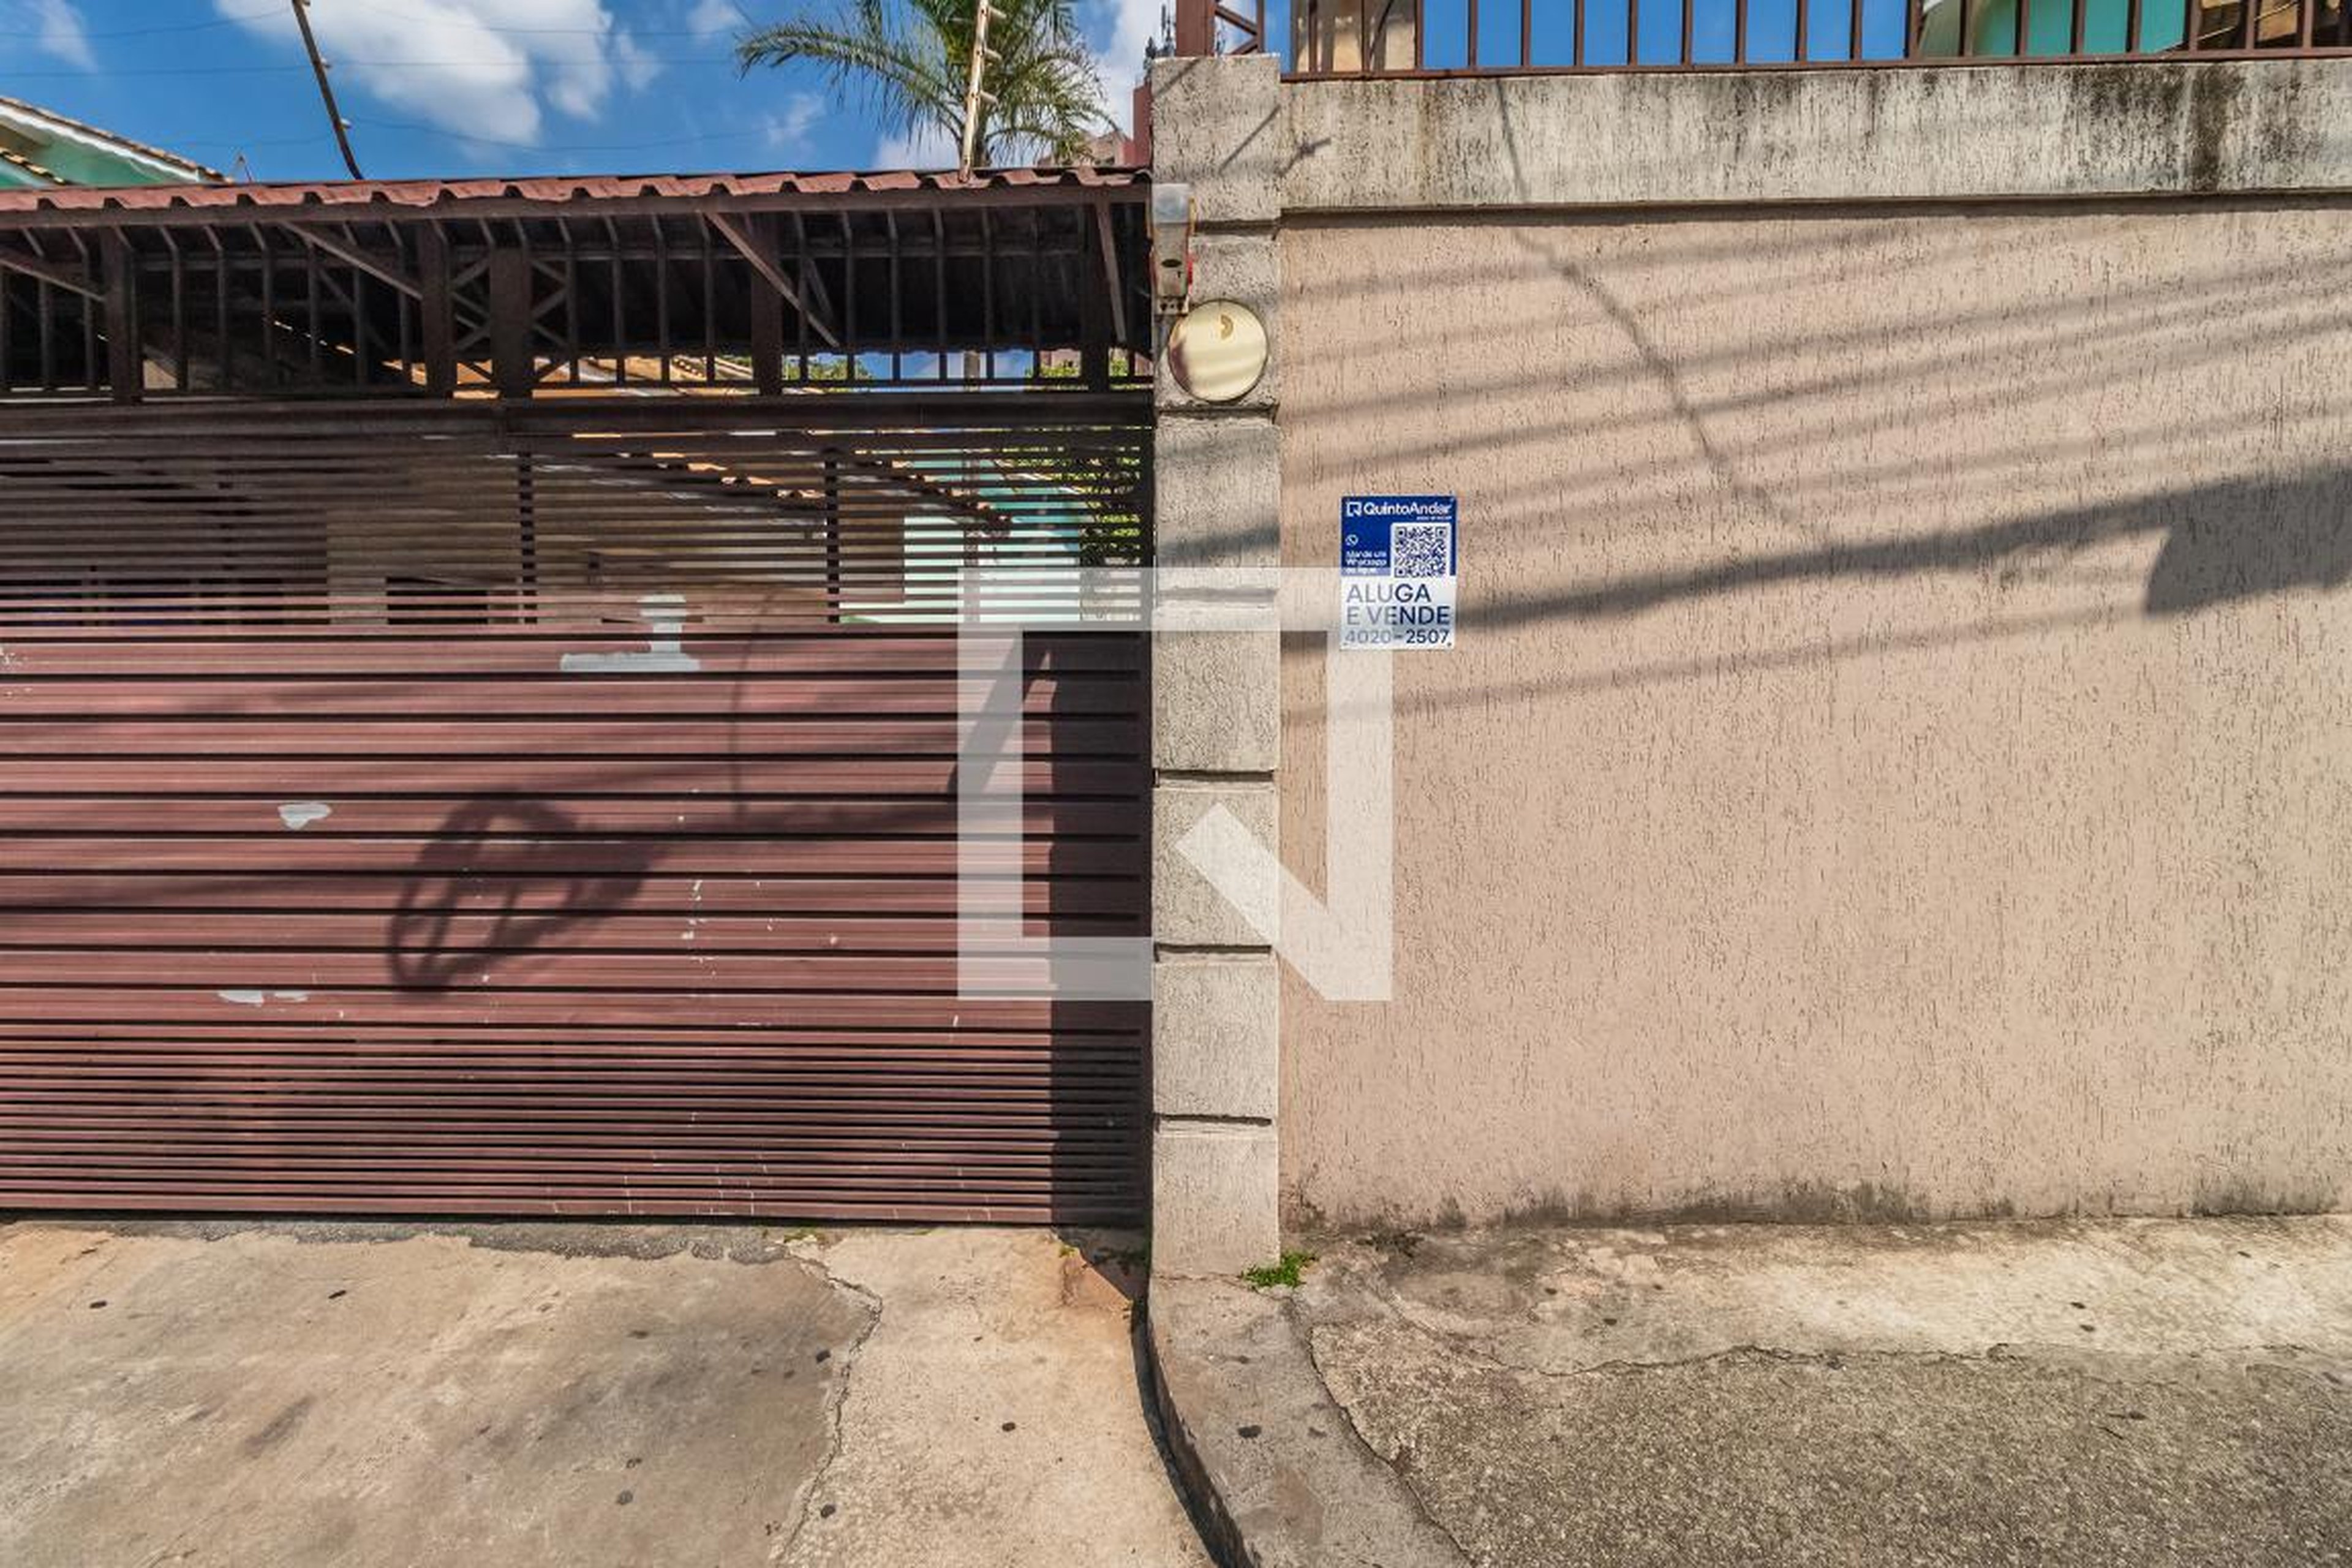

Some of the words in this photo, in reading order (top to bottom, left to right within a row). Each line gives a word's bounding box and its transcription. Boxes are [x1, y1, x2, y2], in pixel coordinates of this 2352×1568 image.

[1363, 502, 1452, 515] QuintoAndar
[1346, 584, 1431, 603] ALUGA
[1347, 606, 1360, 625] E
[1366, 606, 1450, 625] VENDE
[1346, 629, 1450, 644] 4020-2507
